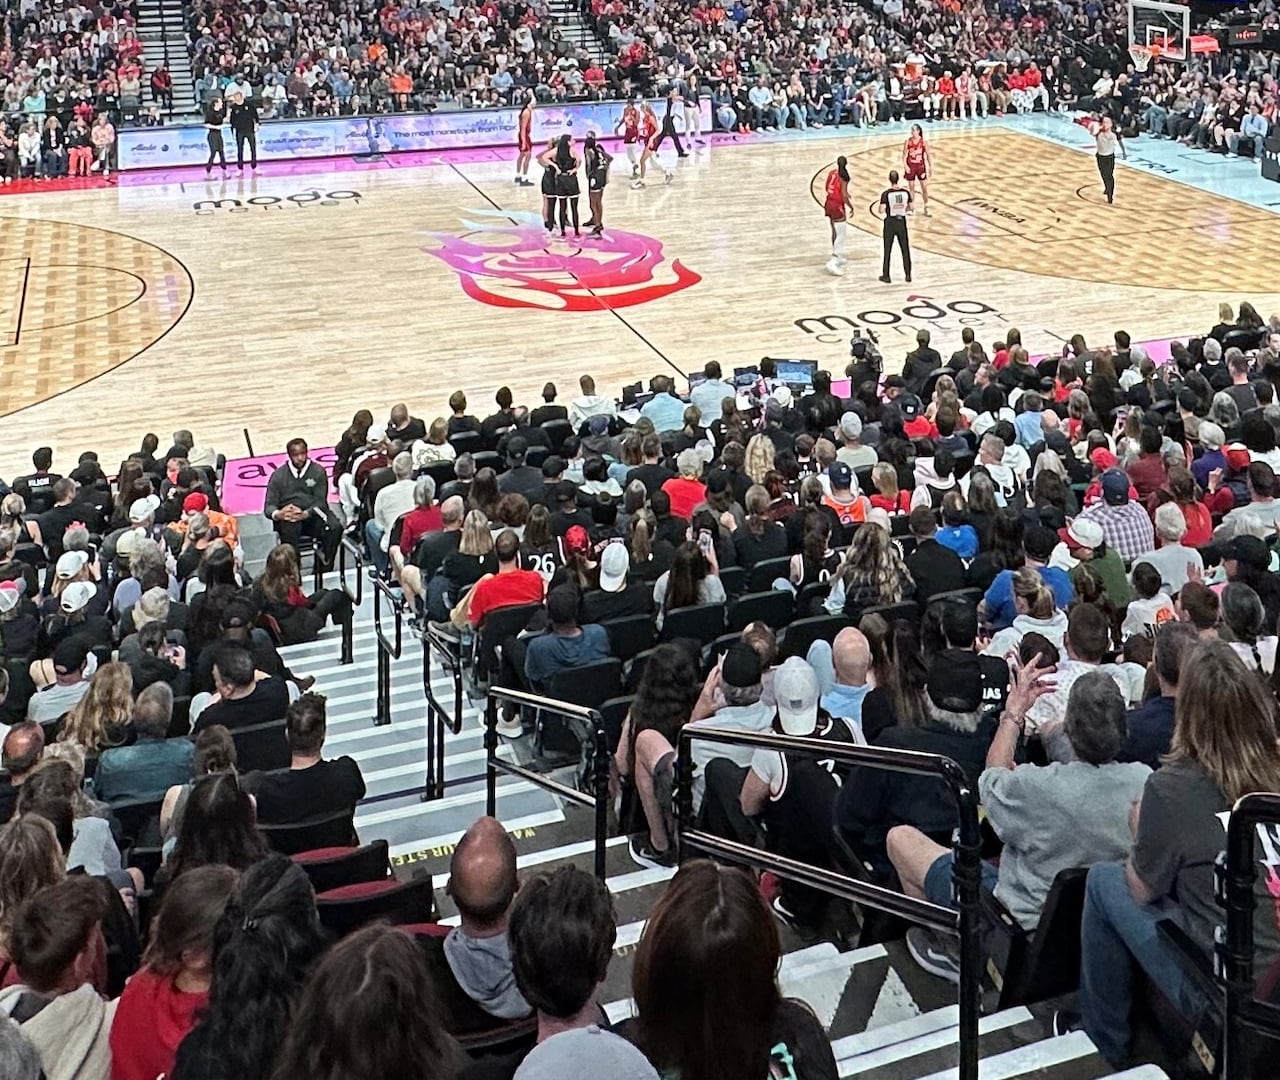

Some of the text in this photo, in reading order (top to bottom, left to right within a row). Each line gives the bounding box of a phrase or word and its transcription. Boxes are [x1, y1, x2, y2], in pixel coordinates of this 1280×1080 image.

[193, 189, 363, 210] moda
[794, 299, 999, 334] moda
[816, 313, 1009, 344] cnter
[528, 552, 556, 580] 26
